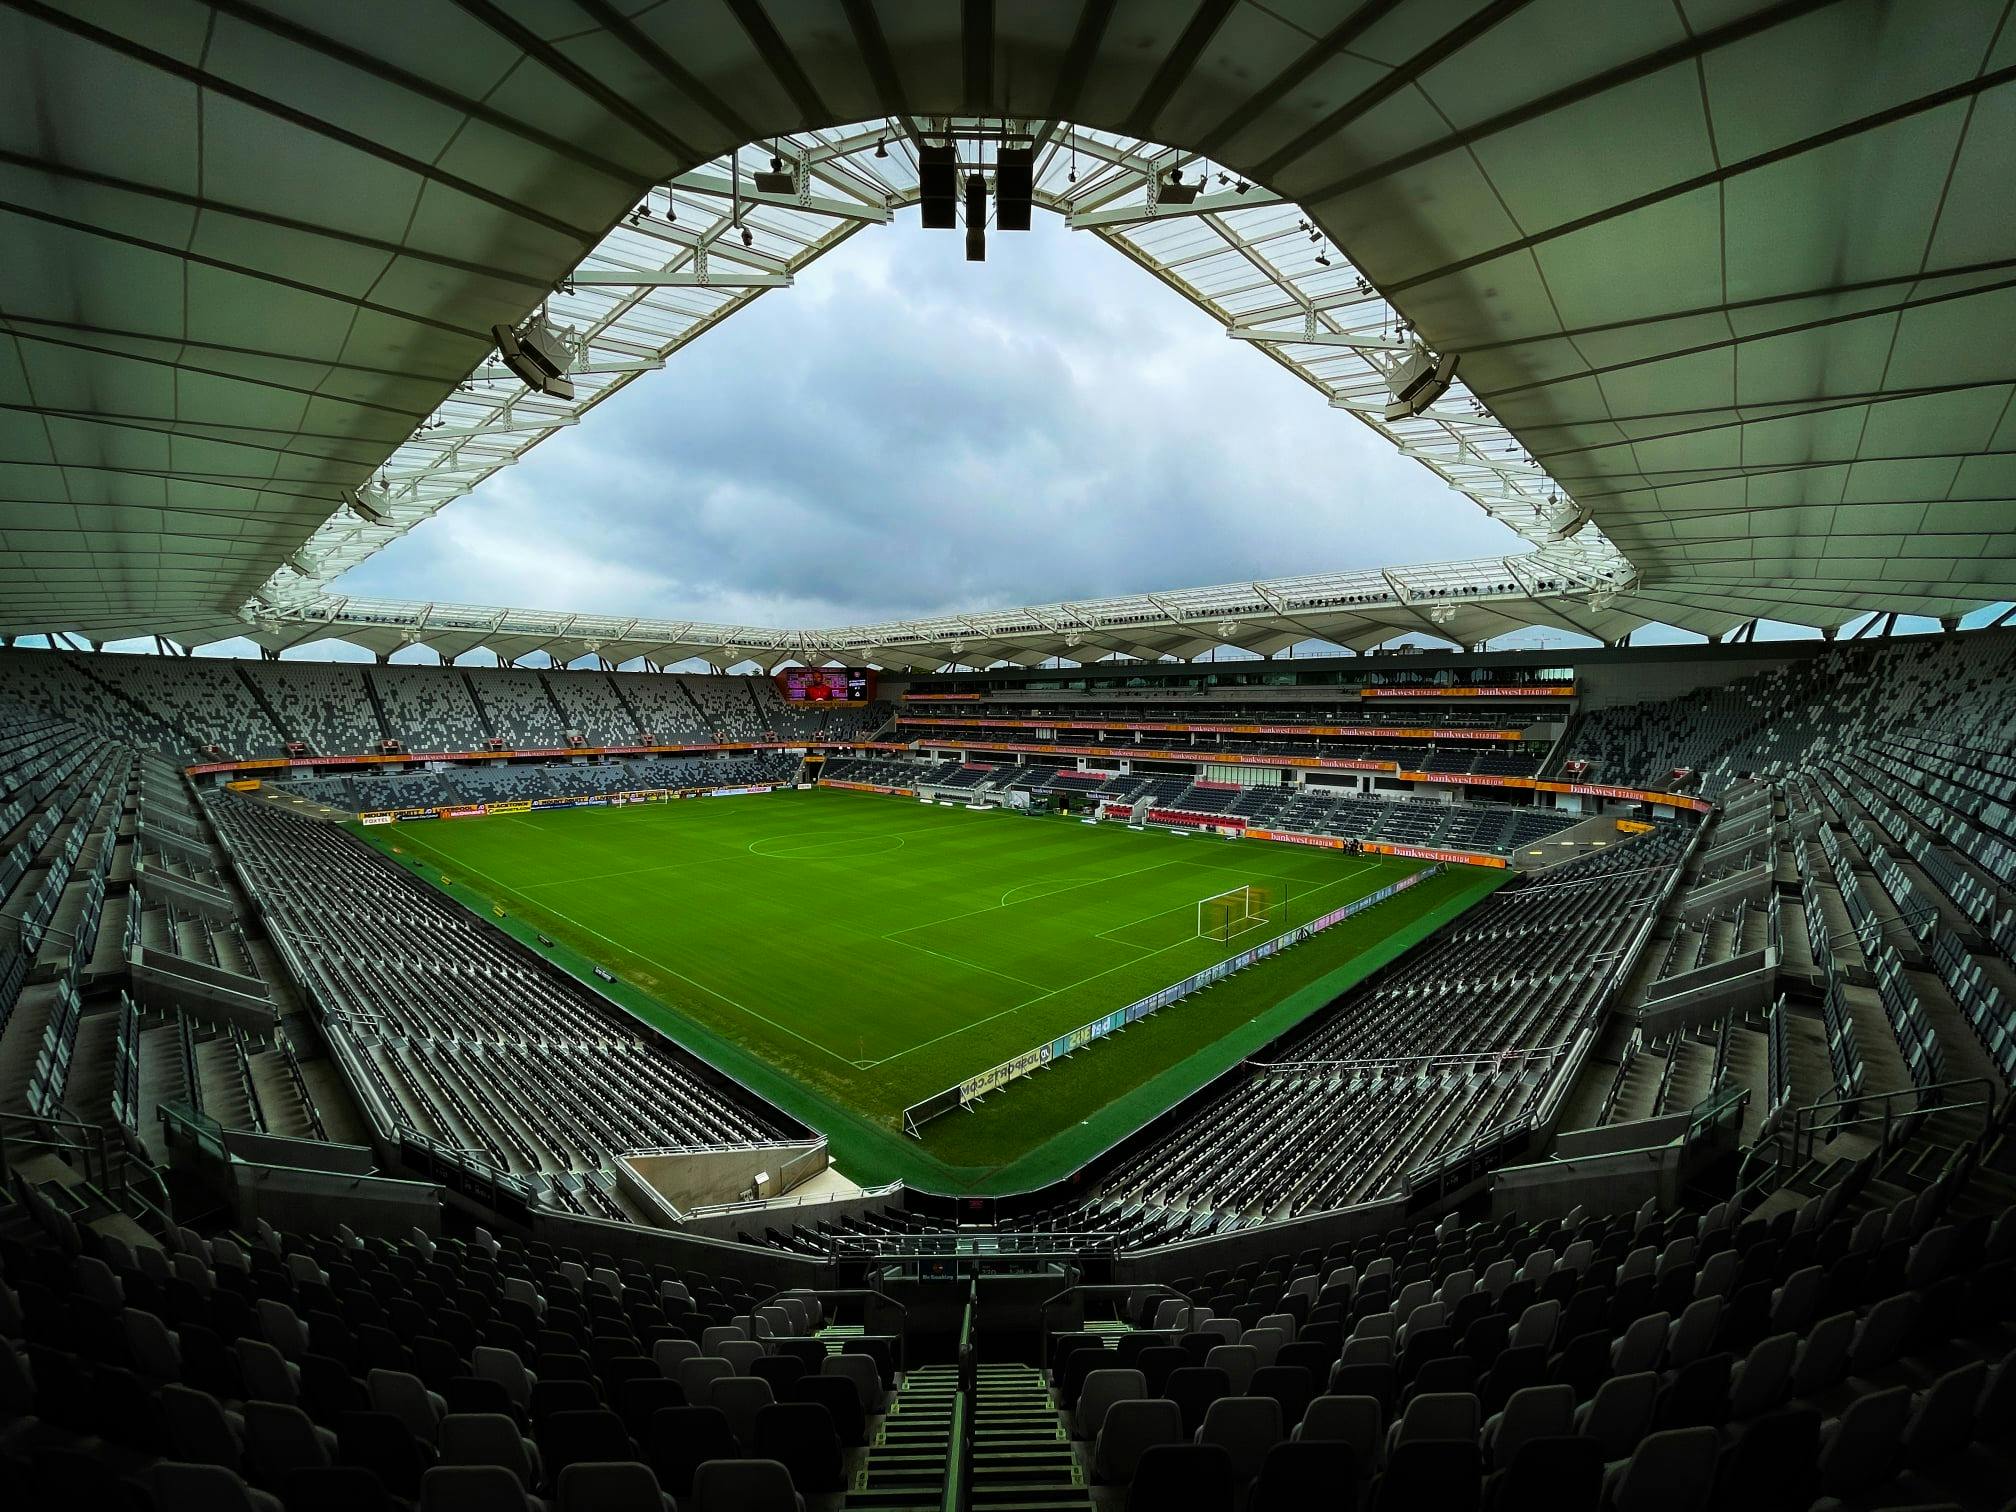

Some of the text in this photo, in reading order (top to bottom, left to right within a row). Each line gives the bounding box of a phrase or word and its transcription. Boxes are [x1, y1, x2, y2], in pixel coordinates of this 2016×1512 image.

[1433, 731, 1472, 739] bankwest
[1240, 756, 1270, 764] bankwest
[1320, 760, 1355, 768] bankwest
[1427, 774, 1472, 784] bankwest
[1570, 784, 1644, 800] bankwest STADIUM
[1271, 833, 1334, 847] bankwest STADIUM
[1394, 846, 1470, 863] bankwest STADIUM
